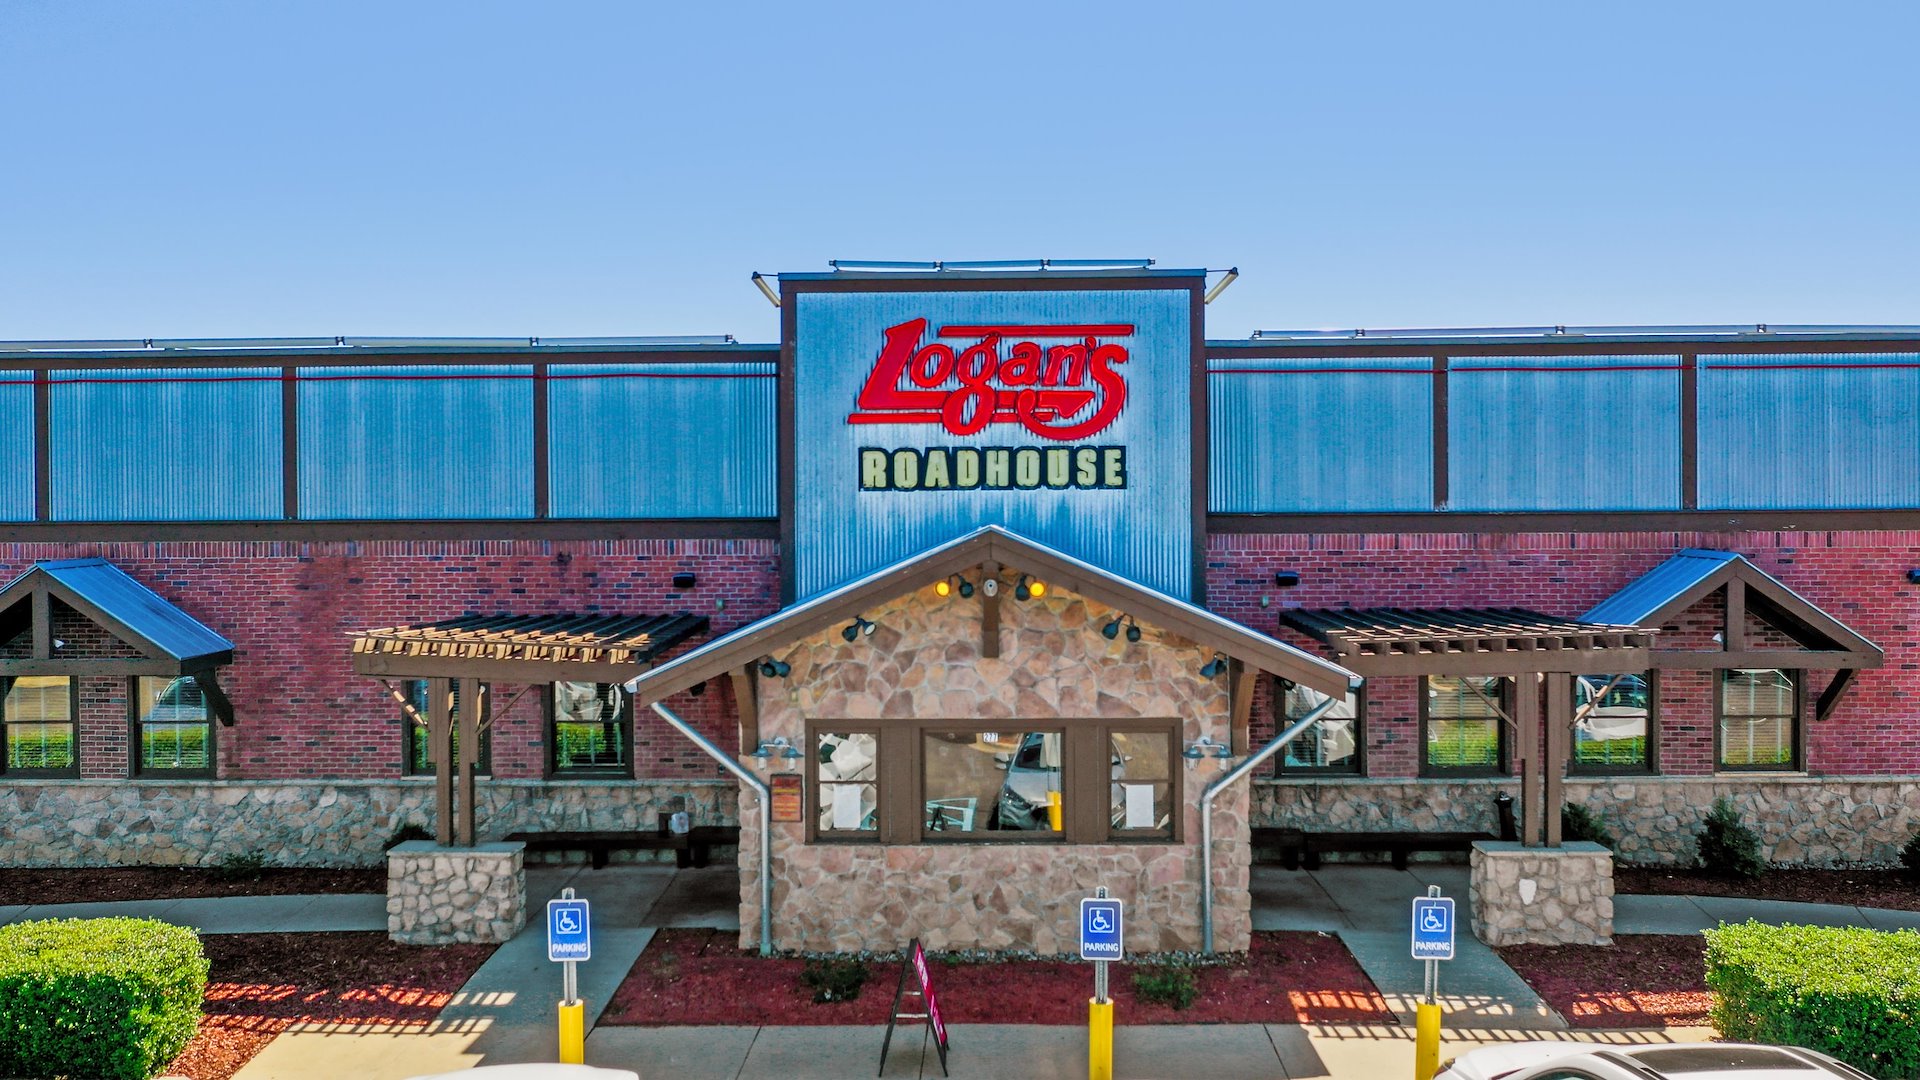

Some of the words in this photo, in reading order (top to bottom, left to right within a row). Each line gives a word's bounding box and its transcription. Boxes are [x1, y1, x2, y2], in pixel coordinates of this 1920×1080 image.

[853, 317, 1130, 441] Logan's
[861, 448, 1125, 489] ROADHOUSE
[552, 943, 587, 953] PARKING
[1084, 942, 1119, 952] PARKING
[1414, 941, 1451, 951] PARKING
